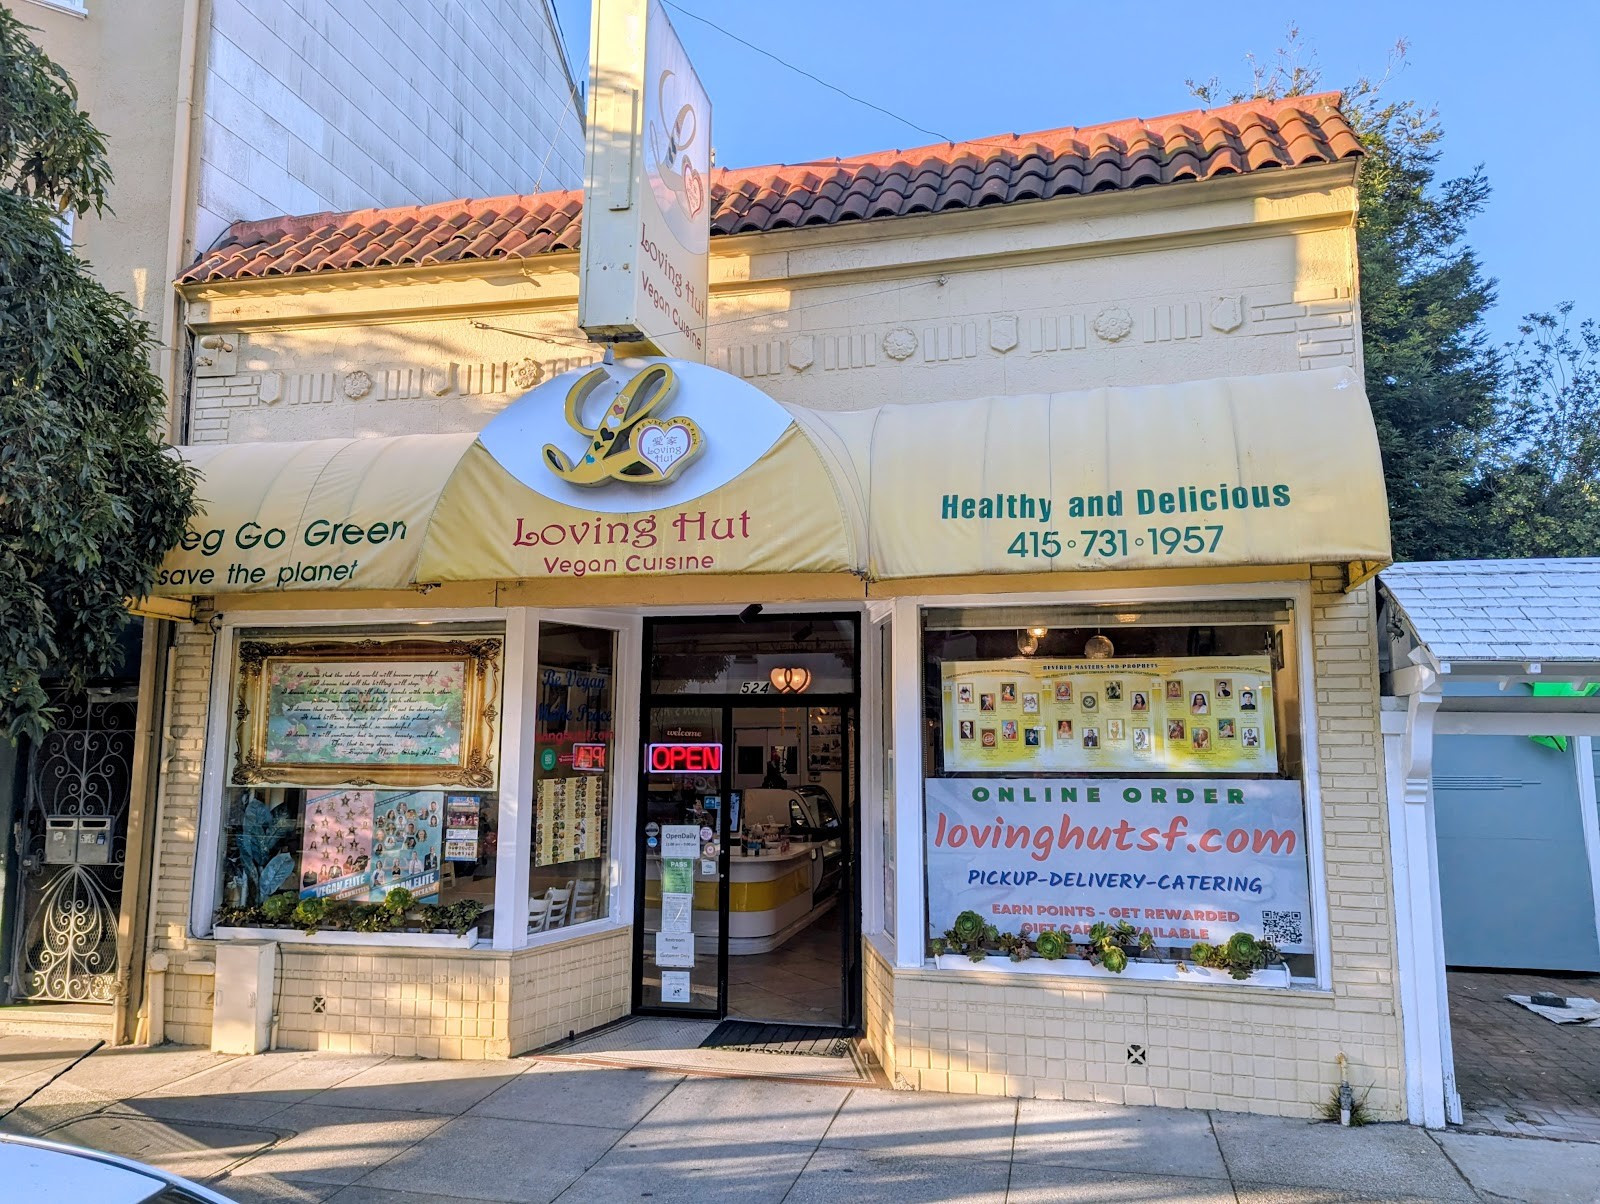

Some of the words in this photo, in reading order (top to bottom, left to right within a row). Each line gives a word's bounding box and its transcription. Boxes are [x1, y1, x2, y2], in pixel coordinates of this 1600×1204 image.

[641, 223, 682, 298] Loving
[685, 281, 705, 319] Hut
[642, 271, 671, 318] Vegan
[672, 308, 702, 350] Cuisine
[647, 446, 682, 455] Loving
[654, 454, 673, 463] Hut
[941, 494, 1051, 522] Healthy
[1069, 490, 1123, 518] and
[1137, 483, 1292, 516] Delicious
[180, 528, 225, 557] eg
[235, 521, 286, 550] Go
[304, 518, 408, 547] Green
[512, 514, 658, 549] Loving
[672, 509, 751, 542] Hut
[158, 568, 215, 586] save
[227, 563, 266, 585] the
[276, 560, 359, 588] planet
[543, 556, 617, 577] Vegan
[625, 554, 715, 573] Cuisine
[542, 668, 561, 688] Be
[566, 670, 606, 693] Vegan
[741, 682, 770, 694] 524
[576, 704, 613, 722] Peace
[666, 727, 702, 738] welcome
[652, 746, 720, 770] OPEN
[971, 786, 1101, 804] ONLINE
[1122, 787, 1246, 805] ORDER
[666, 832, 697, 840] OpenDaily
[934, 812, 1297, 862] lovinghutsf.com
[316, 881, 343, 898] VEGAN
[345, 874, 366, 889] ELITE
[414, 873, 435, 889] ELITE
[967, 869, 1263, 894] PICKUP-DELIVERY-CATERING
[992, 904, 1033, 916] EARN
[1036, 905, 1096, 918] POINTS
[1108, 907, 1141, 919] GET
[1144, 908, 1240, 922] REWARDED
[1021, 922, 1056, 934] GIFT
[1132, 927, 1210, 940] VAILABLE
